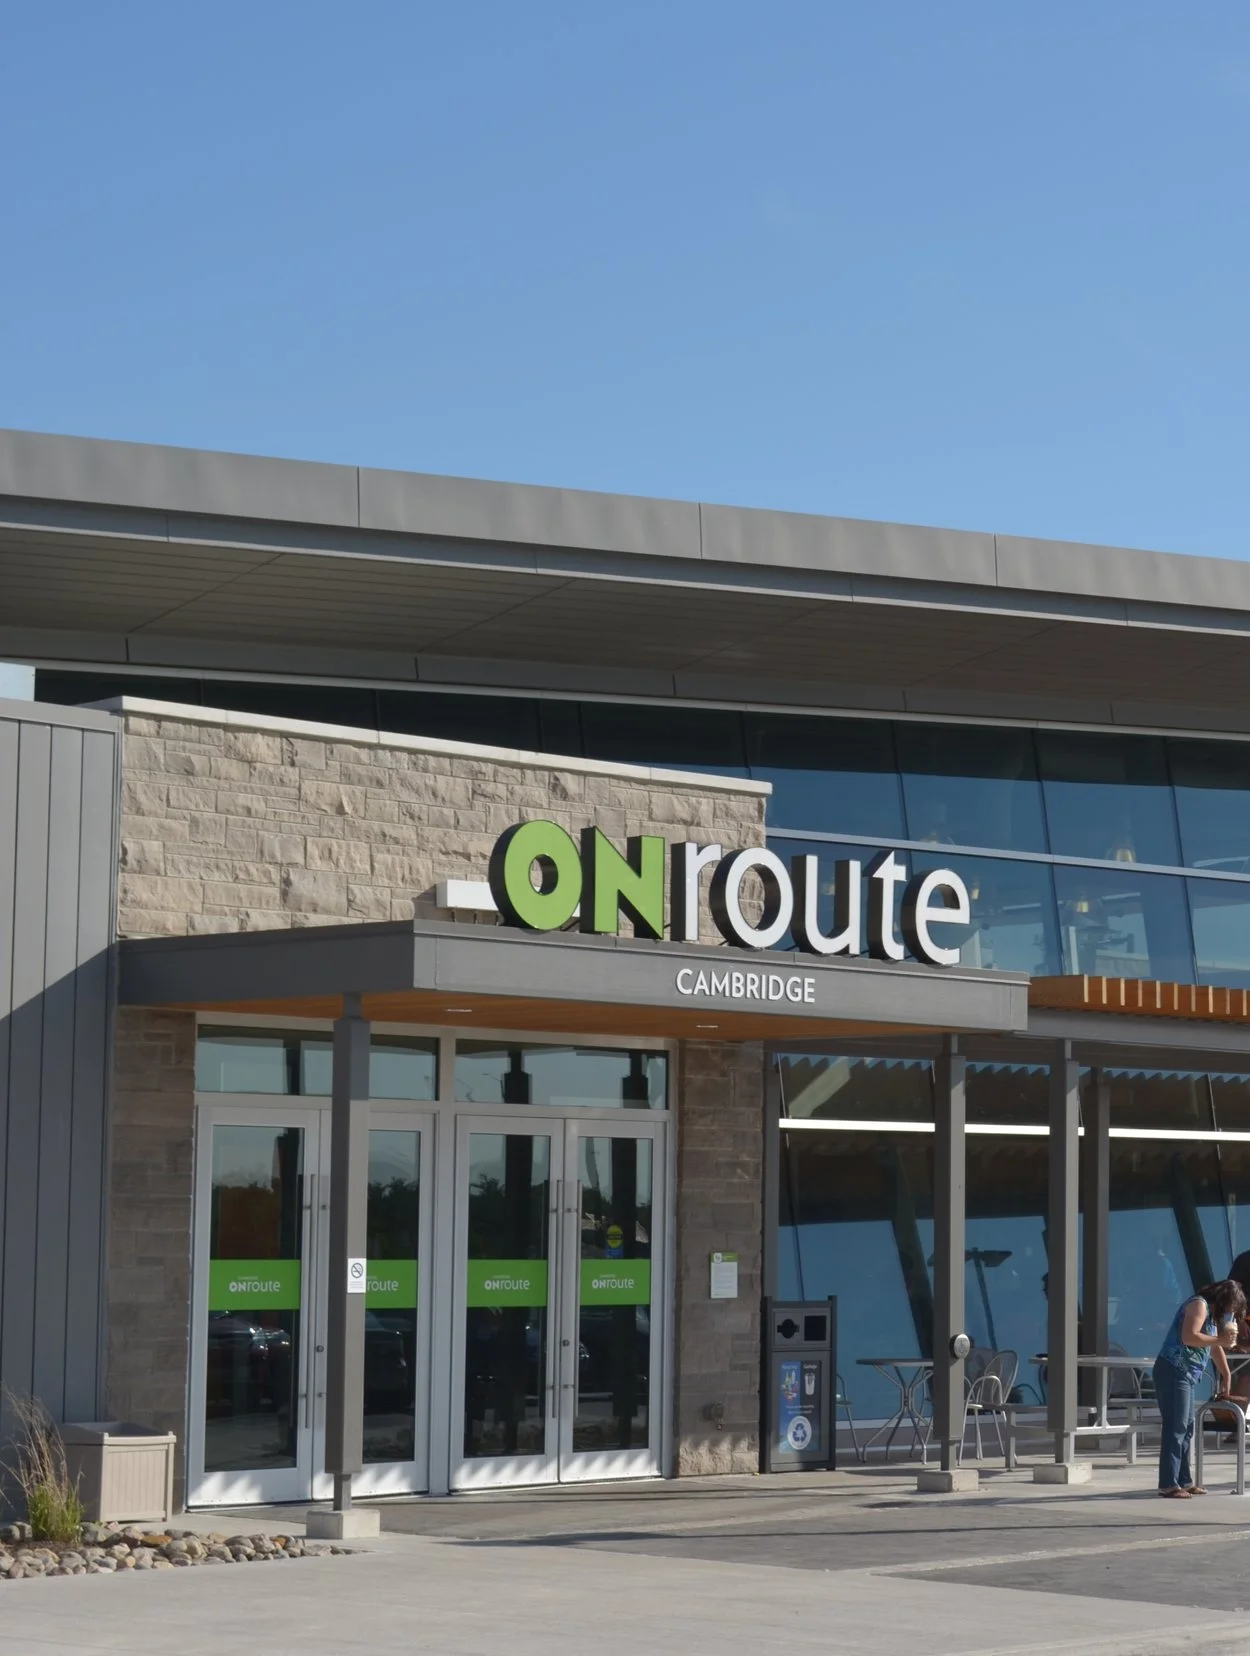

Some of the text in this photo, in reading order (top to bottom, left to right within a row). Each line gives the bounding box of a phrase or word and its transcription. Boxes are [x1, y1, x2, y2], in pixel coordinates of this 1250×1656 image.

[490, 819, 971, 966] ONroute
[675, 968, 816, 1004] CAMBRIDGE
[228, 1281, 281, 1292] ONroute
[367, 1280, 399, 1291] route
[484, 1279, 530, 1290] ONroute
[591, 1278, 635, 1289] ONroute
